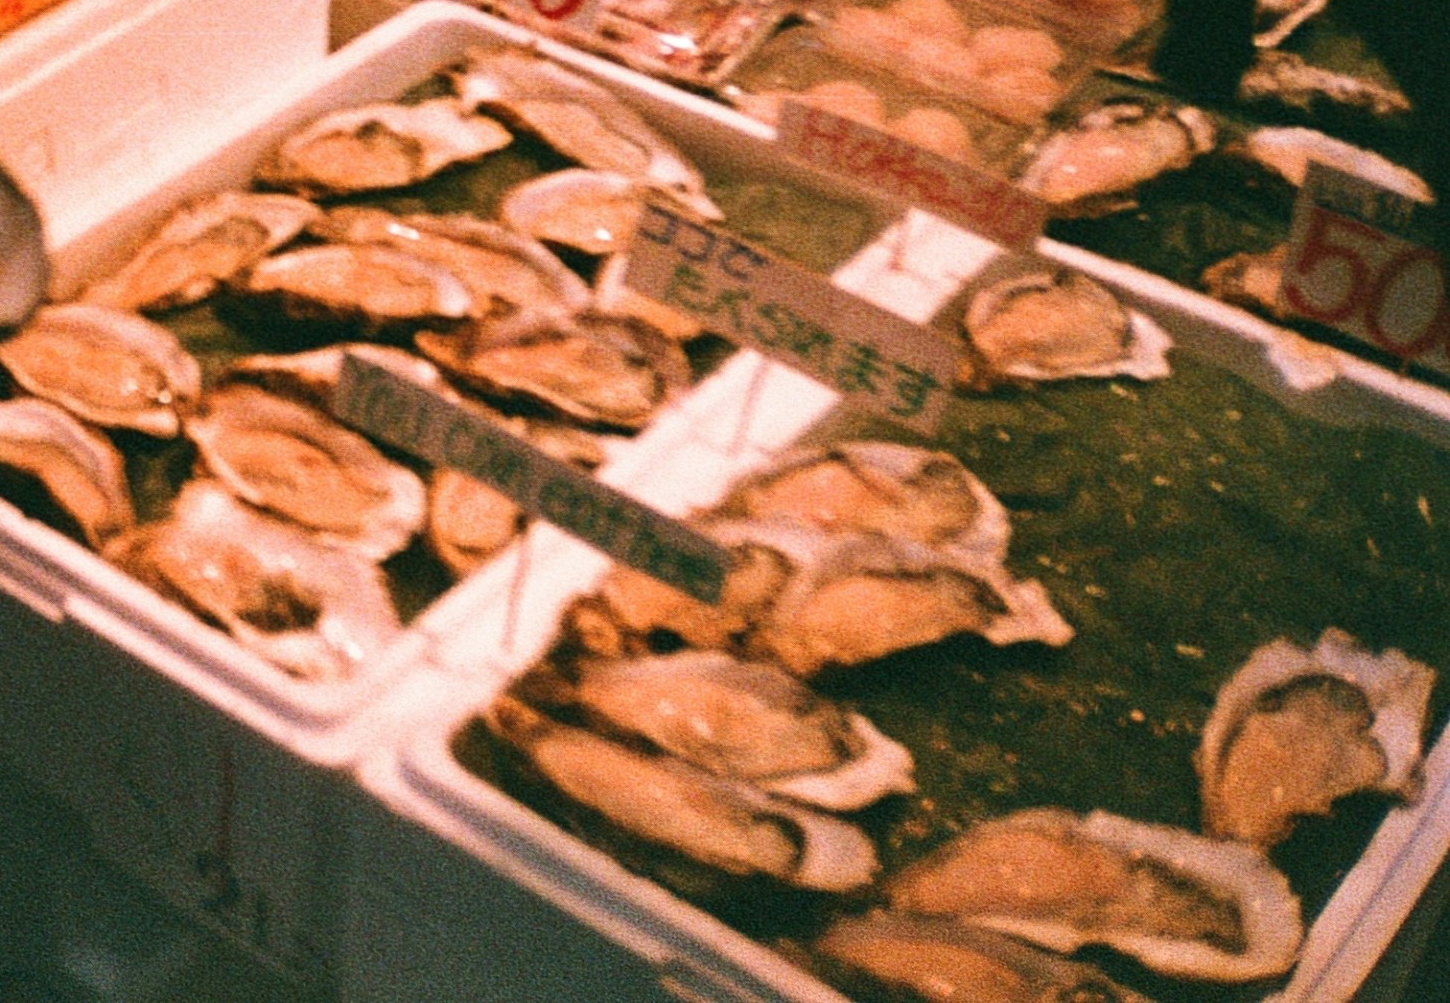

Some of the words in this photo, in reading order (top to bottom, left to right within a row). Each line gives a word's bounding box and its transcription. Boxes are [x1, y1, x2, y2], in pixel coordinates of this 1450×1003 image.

[638, 201, 772, 281] ココで
[1285, 205, 1450, 360] 50
